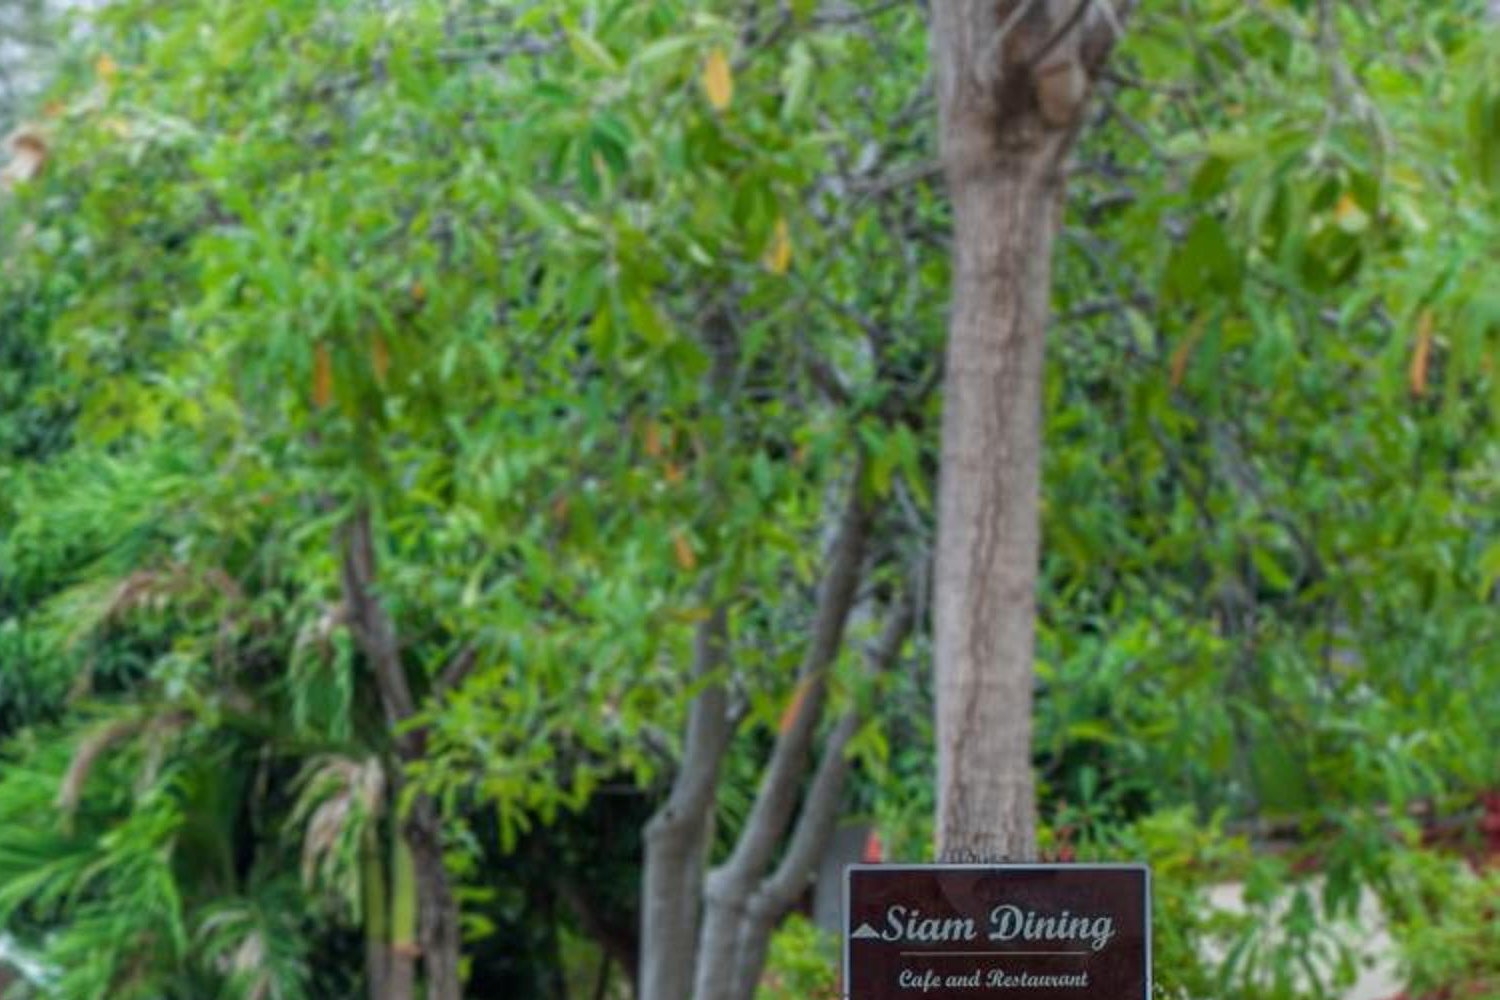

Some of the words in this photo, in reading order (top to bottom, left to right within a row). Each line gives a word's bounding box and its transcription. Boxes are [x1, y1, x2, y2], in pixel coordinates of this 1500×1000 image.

[881, 905, 978, 942] Siam
[988, 903, 1116, 951] Dining
[899, 969, 941, 993] Cafe
[945, 969, 982, 988] and
[985, 970, 1088, 988] Restaurant
